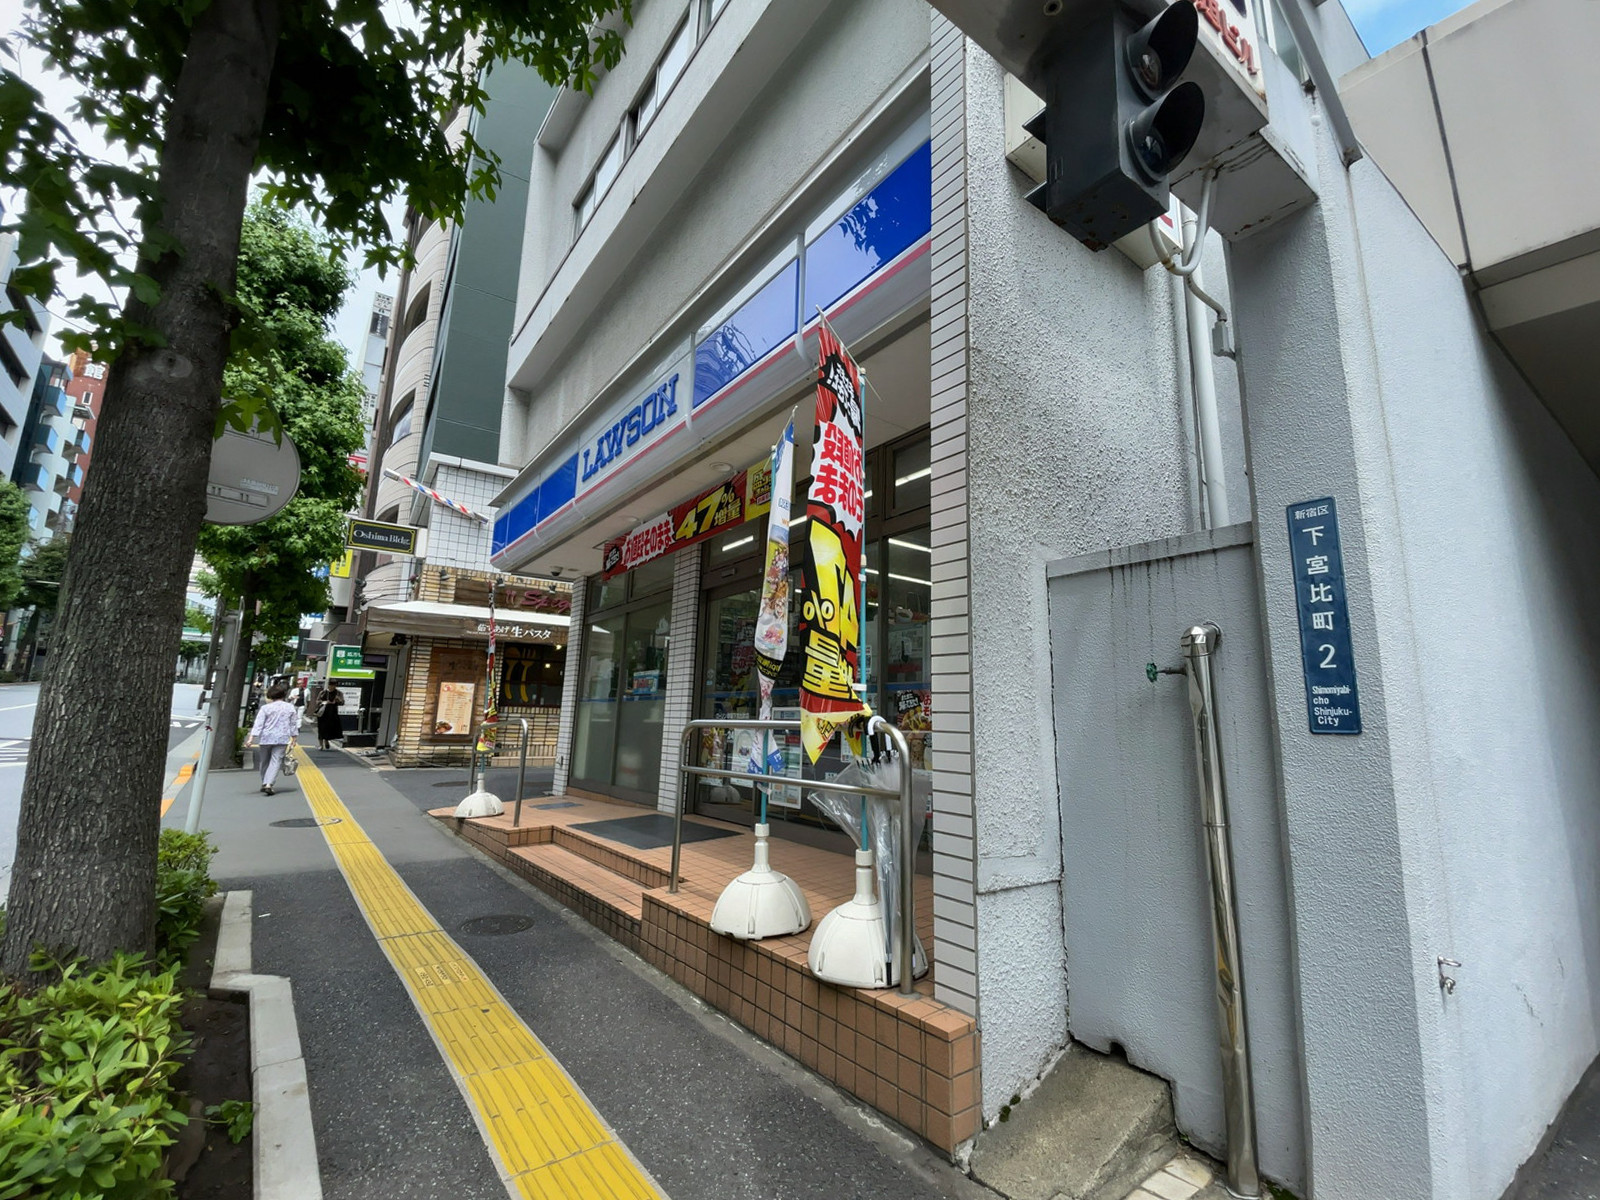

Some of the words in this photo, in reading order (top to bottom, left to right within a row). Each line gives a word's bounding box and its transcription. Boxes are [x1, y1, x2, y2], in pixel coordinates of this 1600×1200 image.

[582, 373, 679, 482] LAWSON
[1294, 504, 1329, 520] 新宿区
[353, 529, 389, 542] Oshima
[624, 518, 672, 564] お値段そのまま
[714, 498, 742, 527] 増量
[1312, 685, 1351, 696] Shimomiyabi-
[1313, 696, 1330, 705] cho
[1314, 706, 1353, 717] Shinjuku-
[1317, 715, 1340, 727] City
